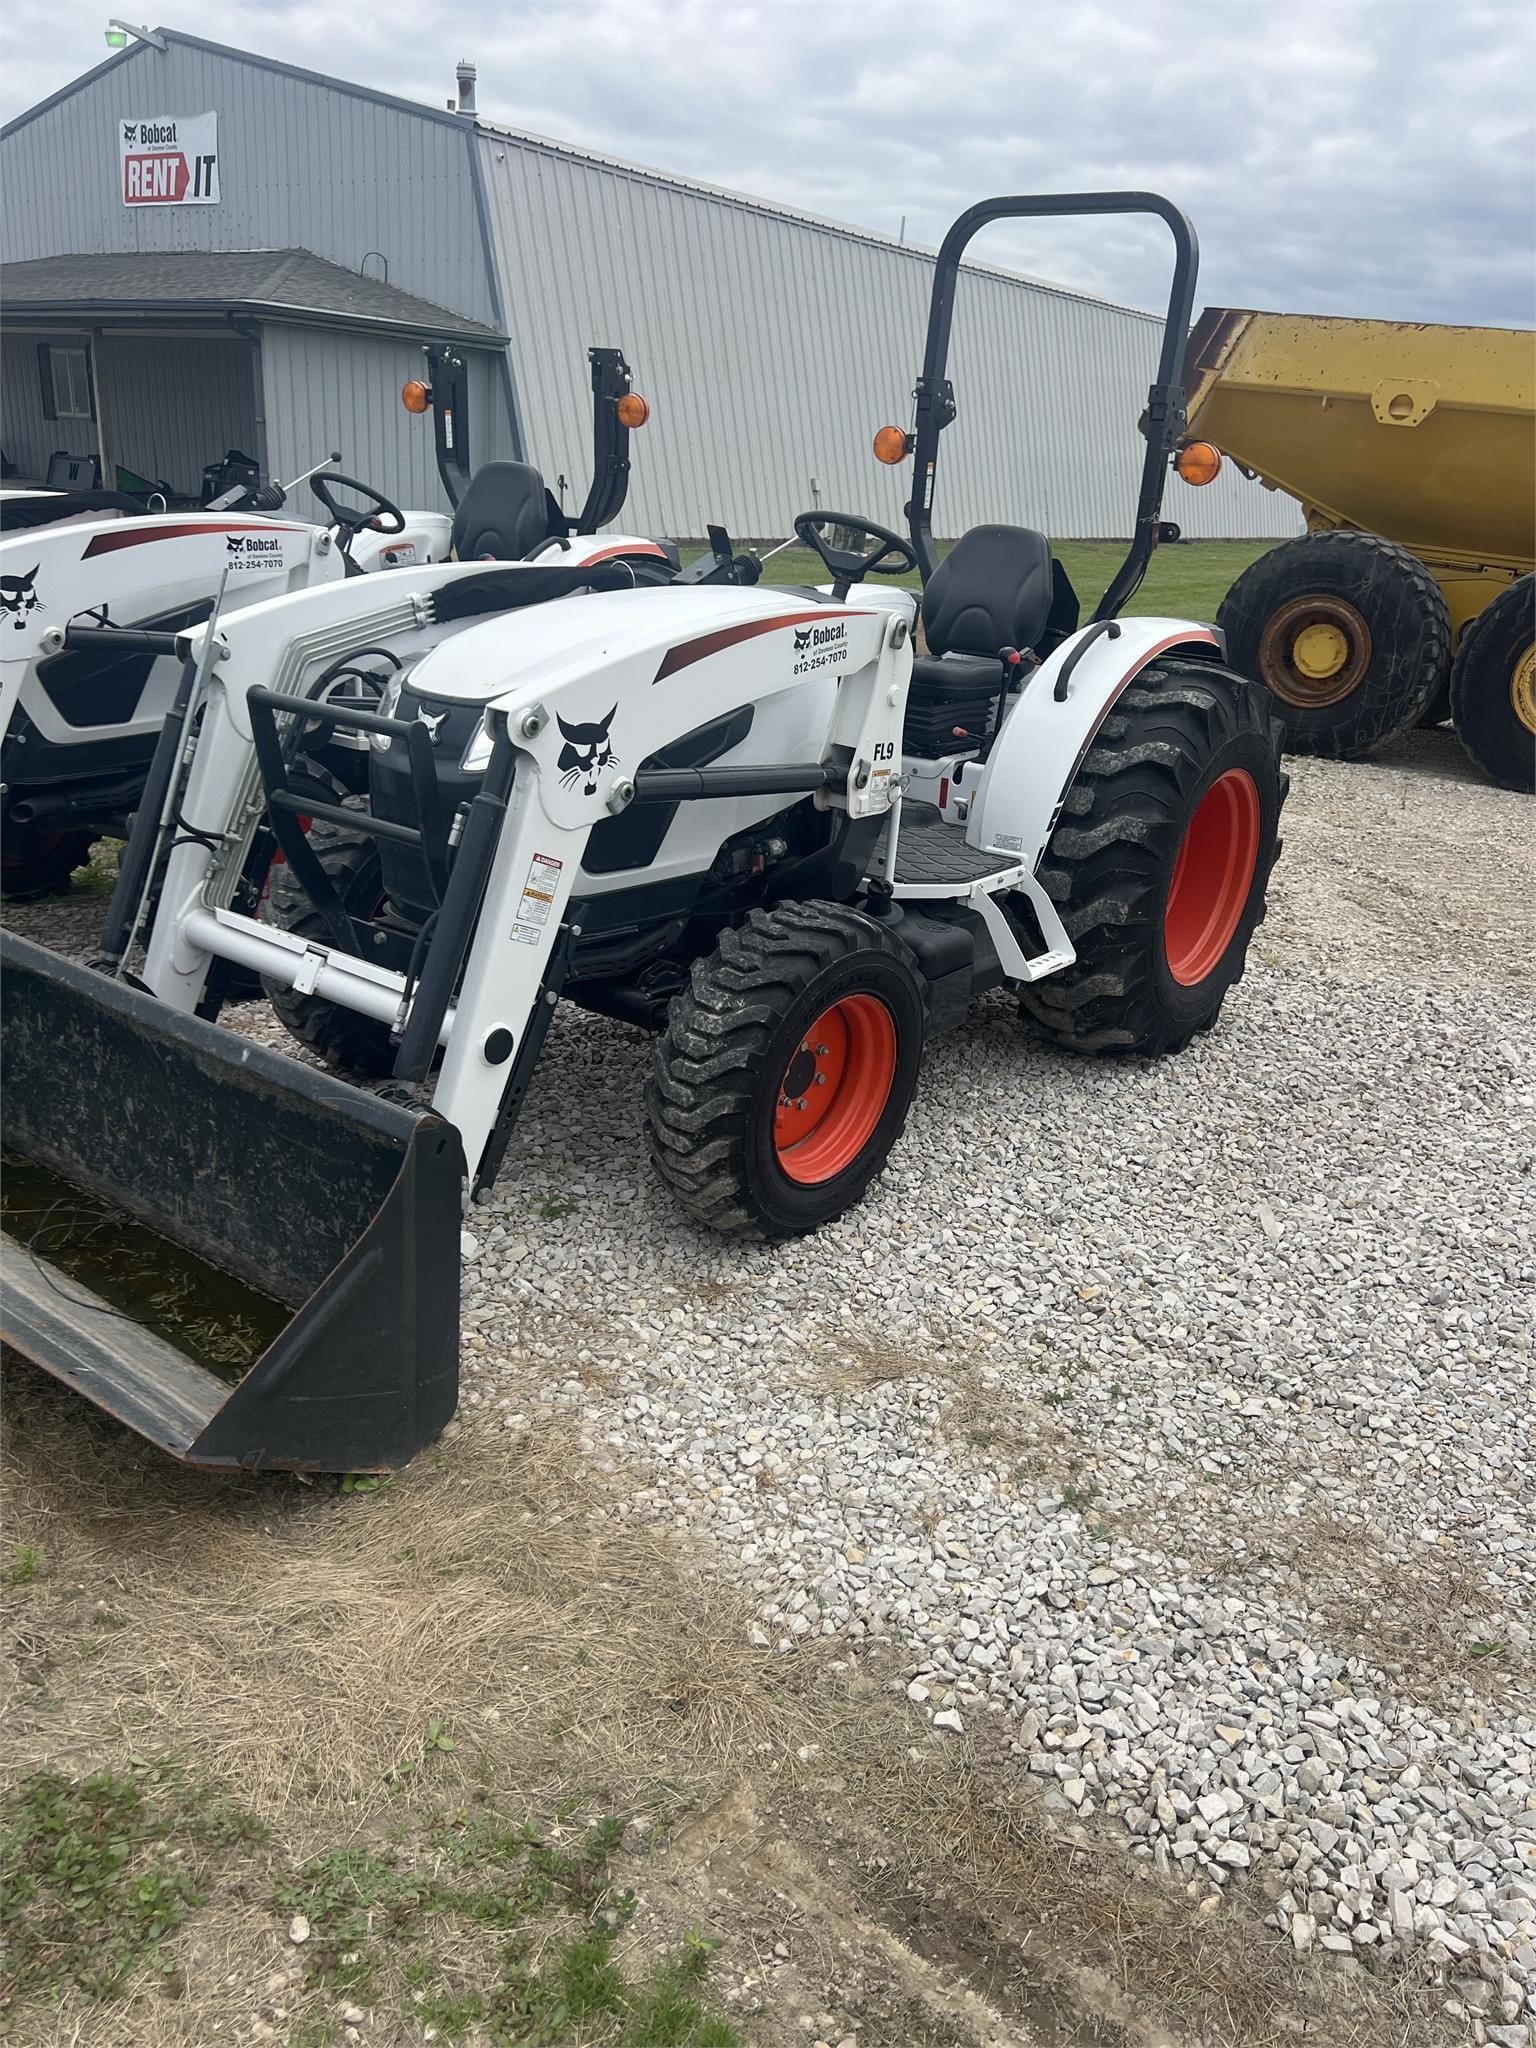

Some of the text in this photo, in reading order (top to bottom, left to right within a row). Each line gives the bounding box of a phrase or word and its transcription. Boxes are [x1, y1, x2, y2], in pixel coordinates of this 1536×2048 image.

[140, 123, 177, 144] Bobcat
[128, 155, 216, 197] RENT IT
[246, 538, 279, 552] Bobcat
[228, 559, 283, 570] 812-254-7070
[813, 622, 845, 647] Bobcat
[793, 649, 847, 675] 812-254-7070
[873, 742, 894, 761] FL9
